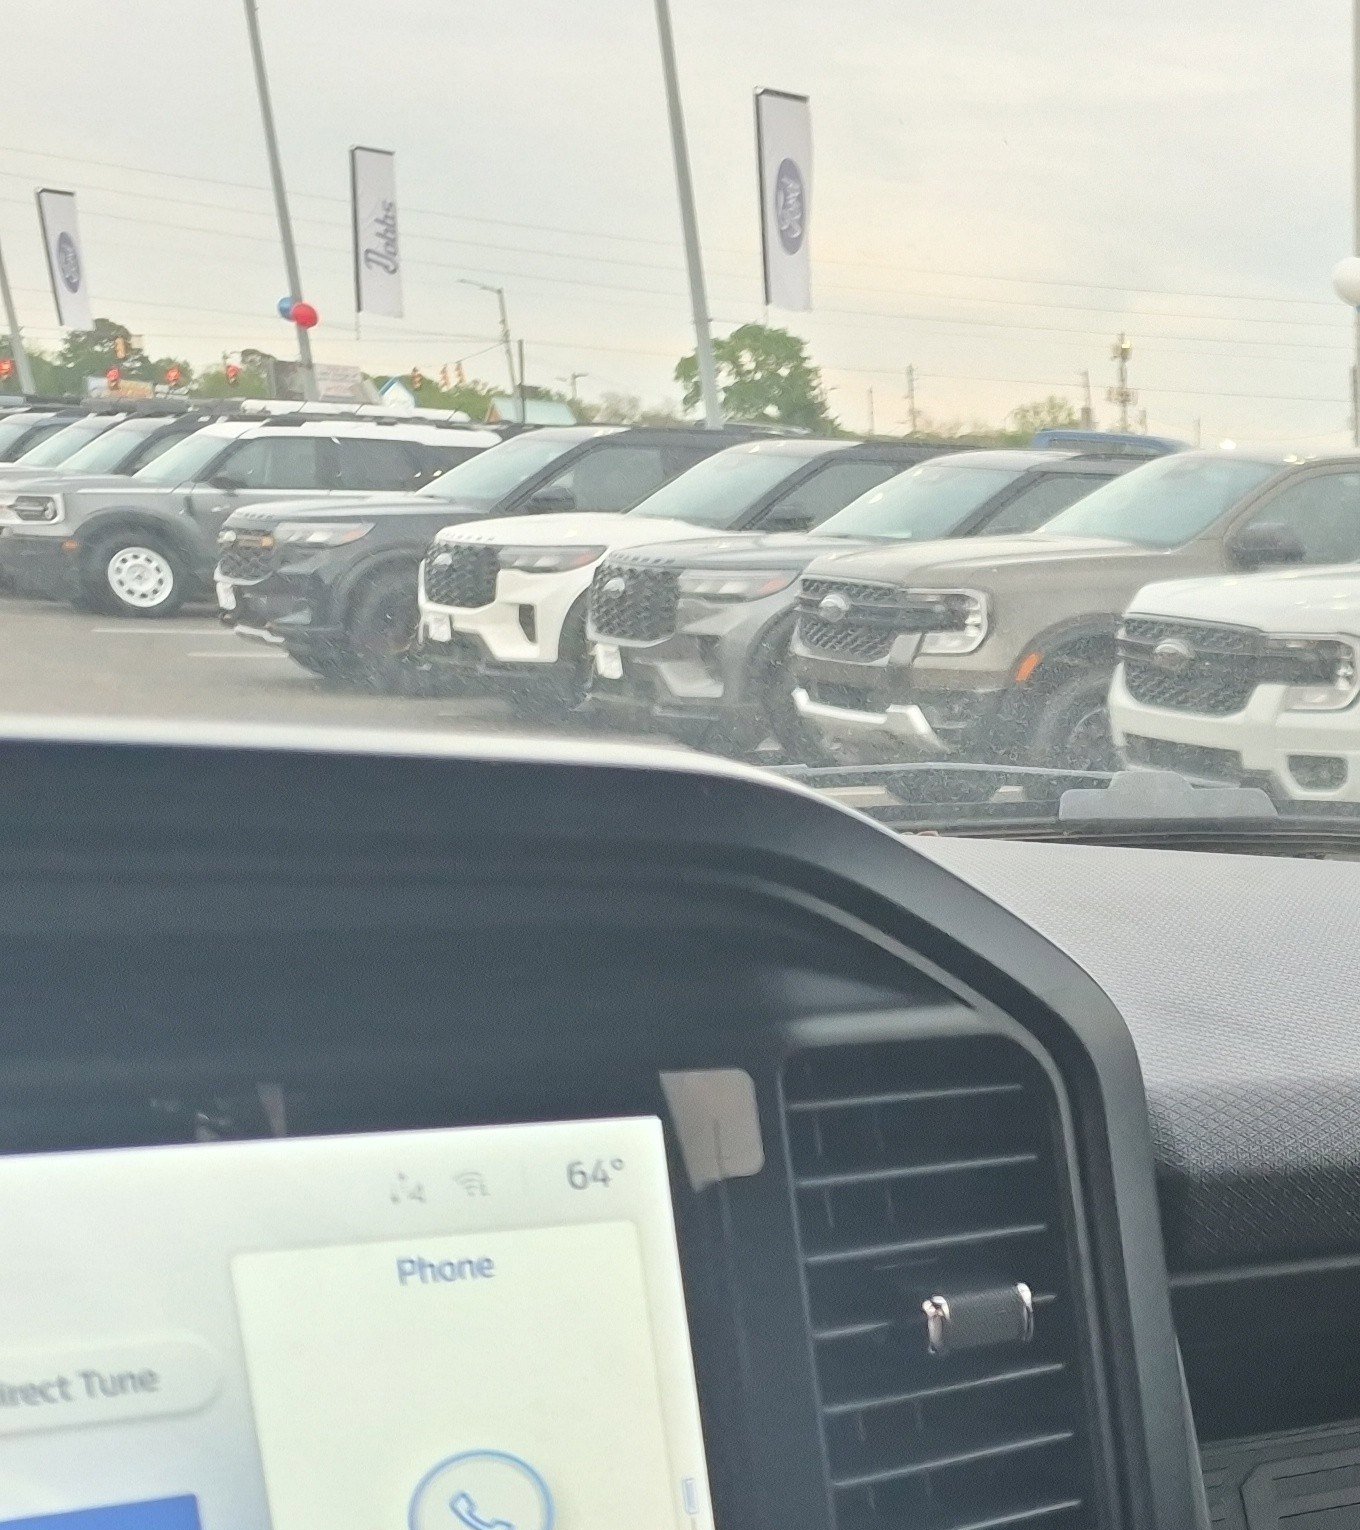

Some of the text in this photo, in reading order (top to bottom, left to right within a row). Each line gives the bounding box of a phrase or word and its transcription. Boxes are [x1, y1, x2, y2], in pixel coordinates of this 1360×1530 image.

[364, 200, 398, 275] Dobbs
[566, 1157, 624, 1191] 64°
[396, 1255, 496, 1286] Phone
[0, 1367, 159, 1407] irect Tune
